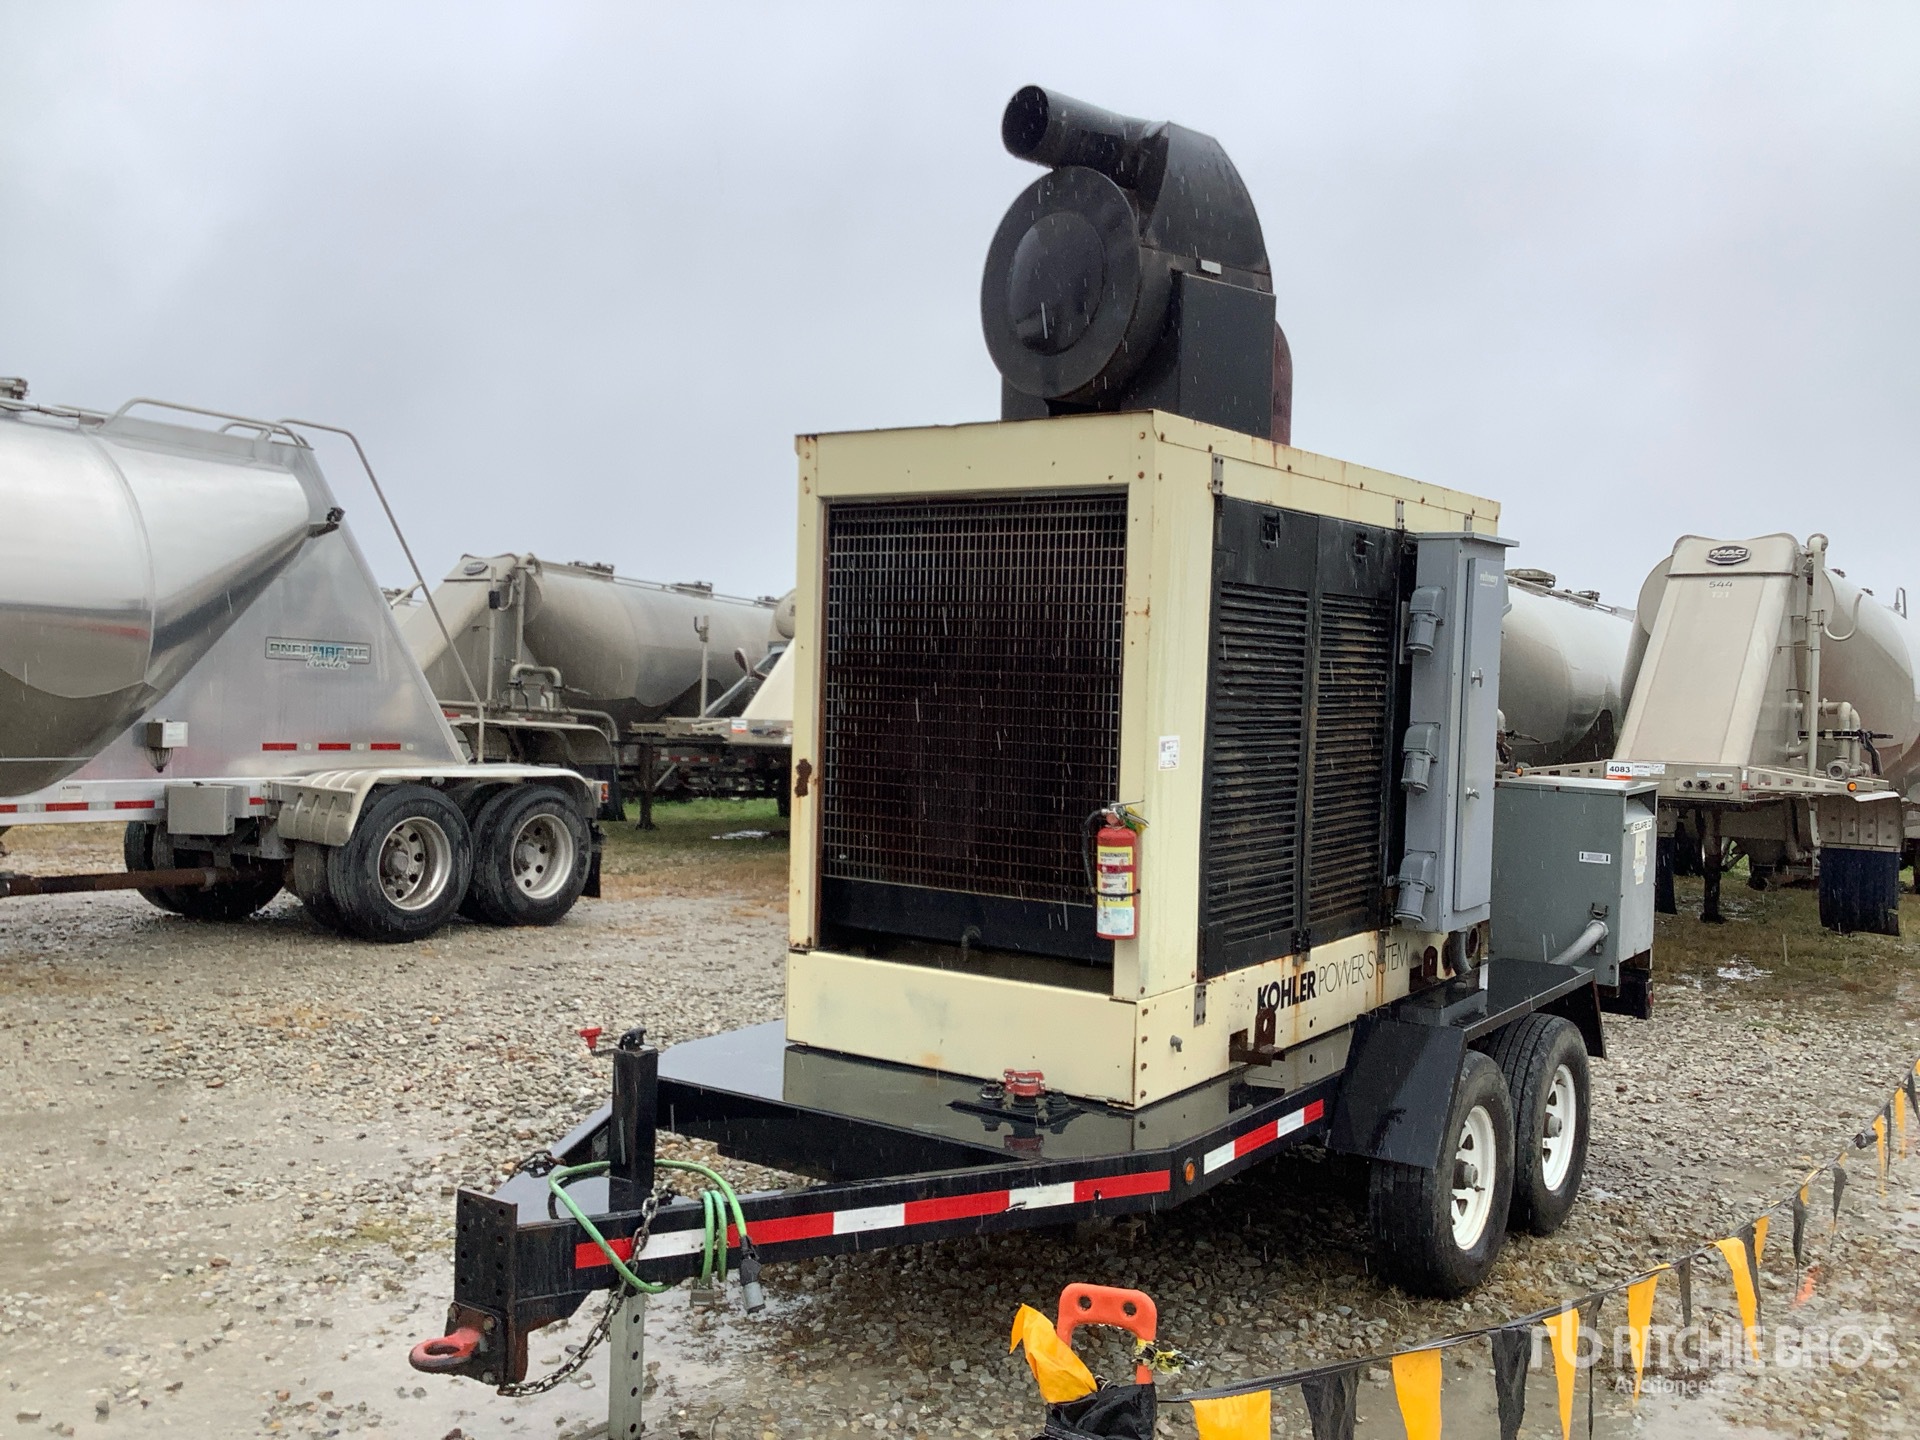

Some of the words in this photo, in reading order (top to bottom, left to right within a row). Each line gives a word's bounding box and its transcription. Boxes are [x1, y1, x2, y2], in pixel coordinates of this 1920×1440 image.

[1708, 580, 1733, 589] 544
[1257, 970, 1316, 1011] KOHLER
[1318, 953, 1365, 996] POWER
